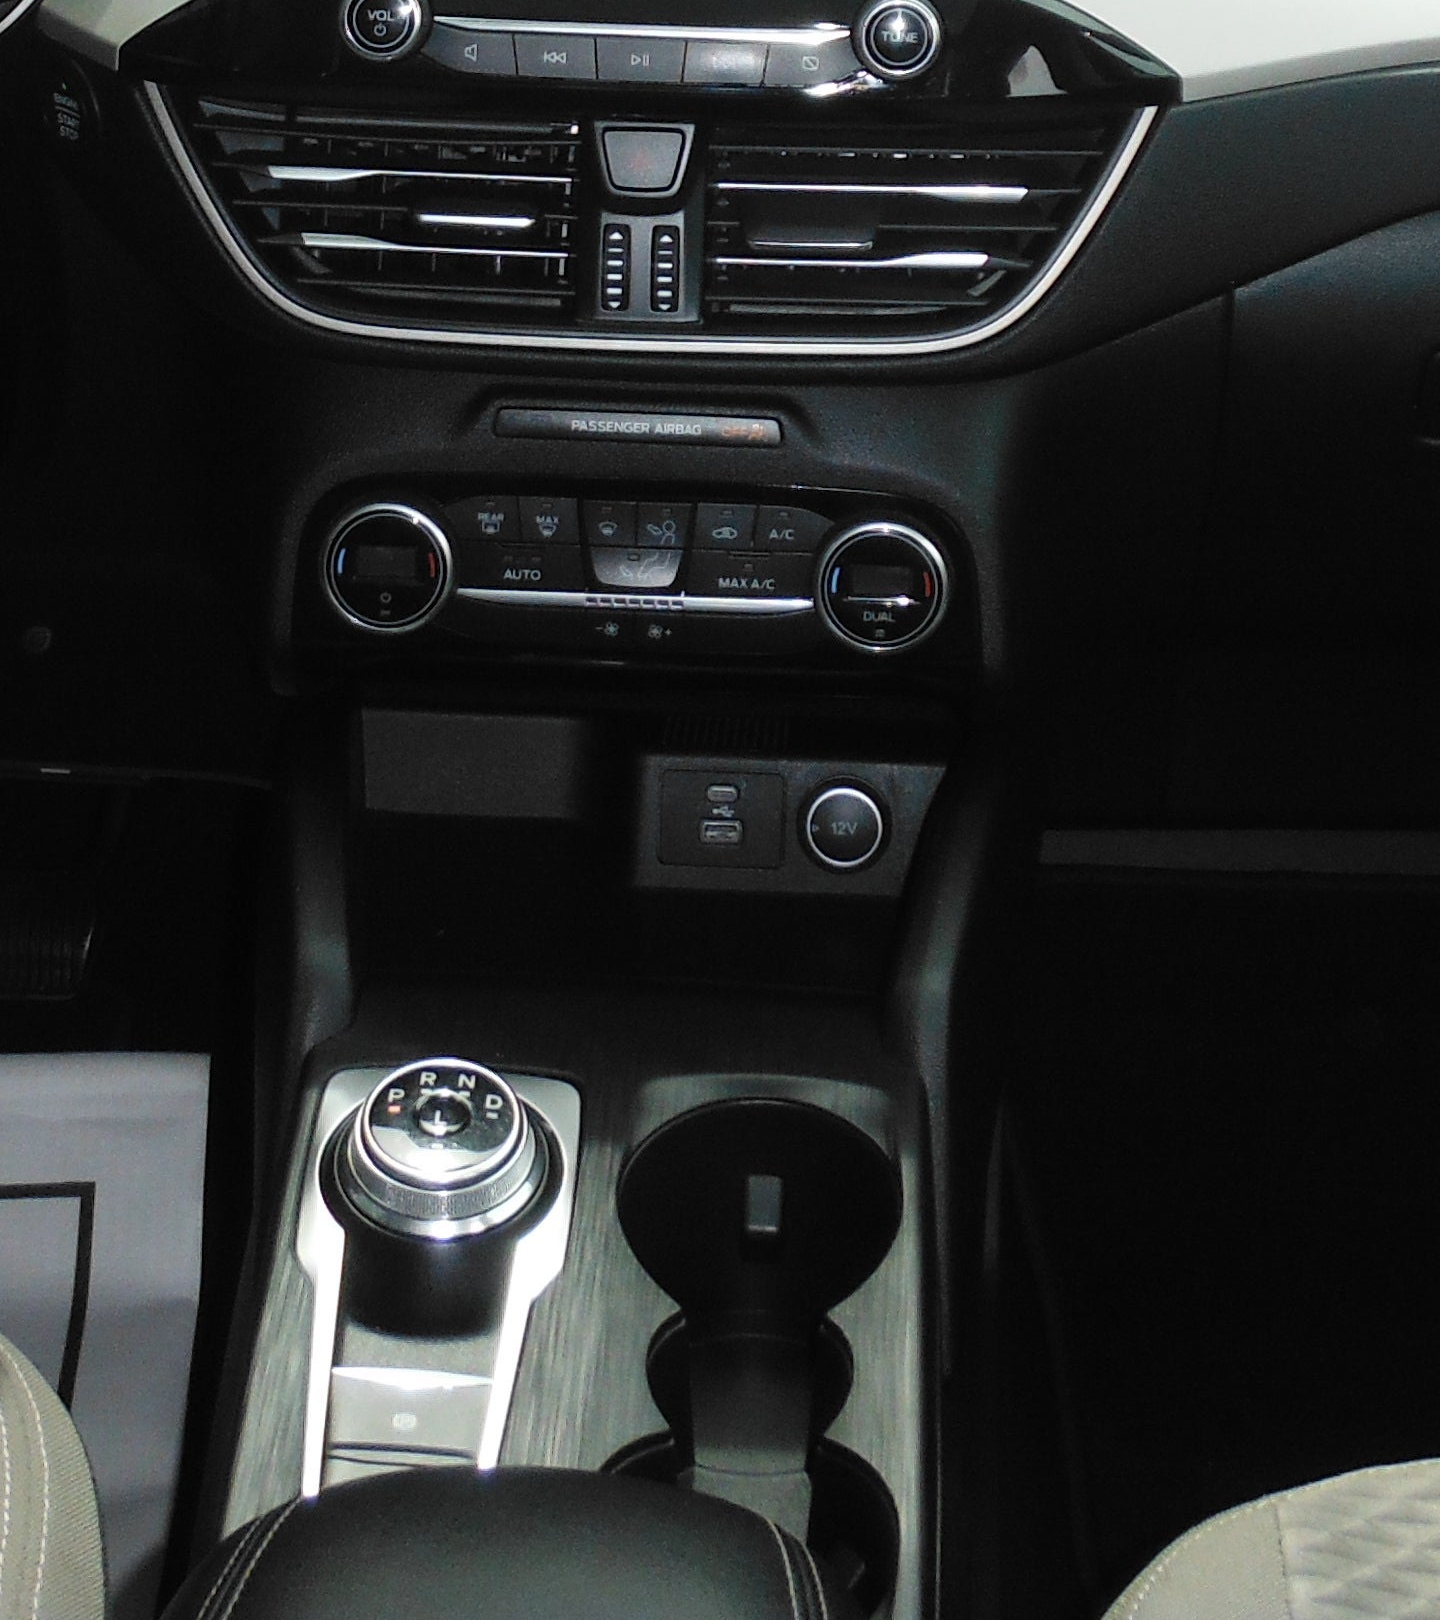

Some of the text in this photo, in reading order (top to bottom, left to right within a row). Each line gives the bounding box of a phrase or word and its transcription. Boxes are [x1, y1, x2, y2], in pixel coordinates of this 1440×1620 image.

[367, 8, 395, 22] VOL
[880, 30, 919, 43] TUNE
[570, 418, 650, 435] PASSENGER
[654, 422, 702, 437] AIRBAG
[535, 515, 560, 524] MAX
[768, 526, 796, 542] A/C
[503, 567, 542, 581] AUTO
[717, 577, 776, 590] MAX A/C
[862, 610, 896, 622] DUAL
[831, 821, 858, 837] 12V
[420, 1071, 437, 1086] R
[459, 1073, 476, 1089] N
[387, 1088, 405, 1103] P
[485, 1094, 503, 1110] D
[434, 1109, 447, 1125] L
